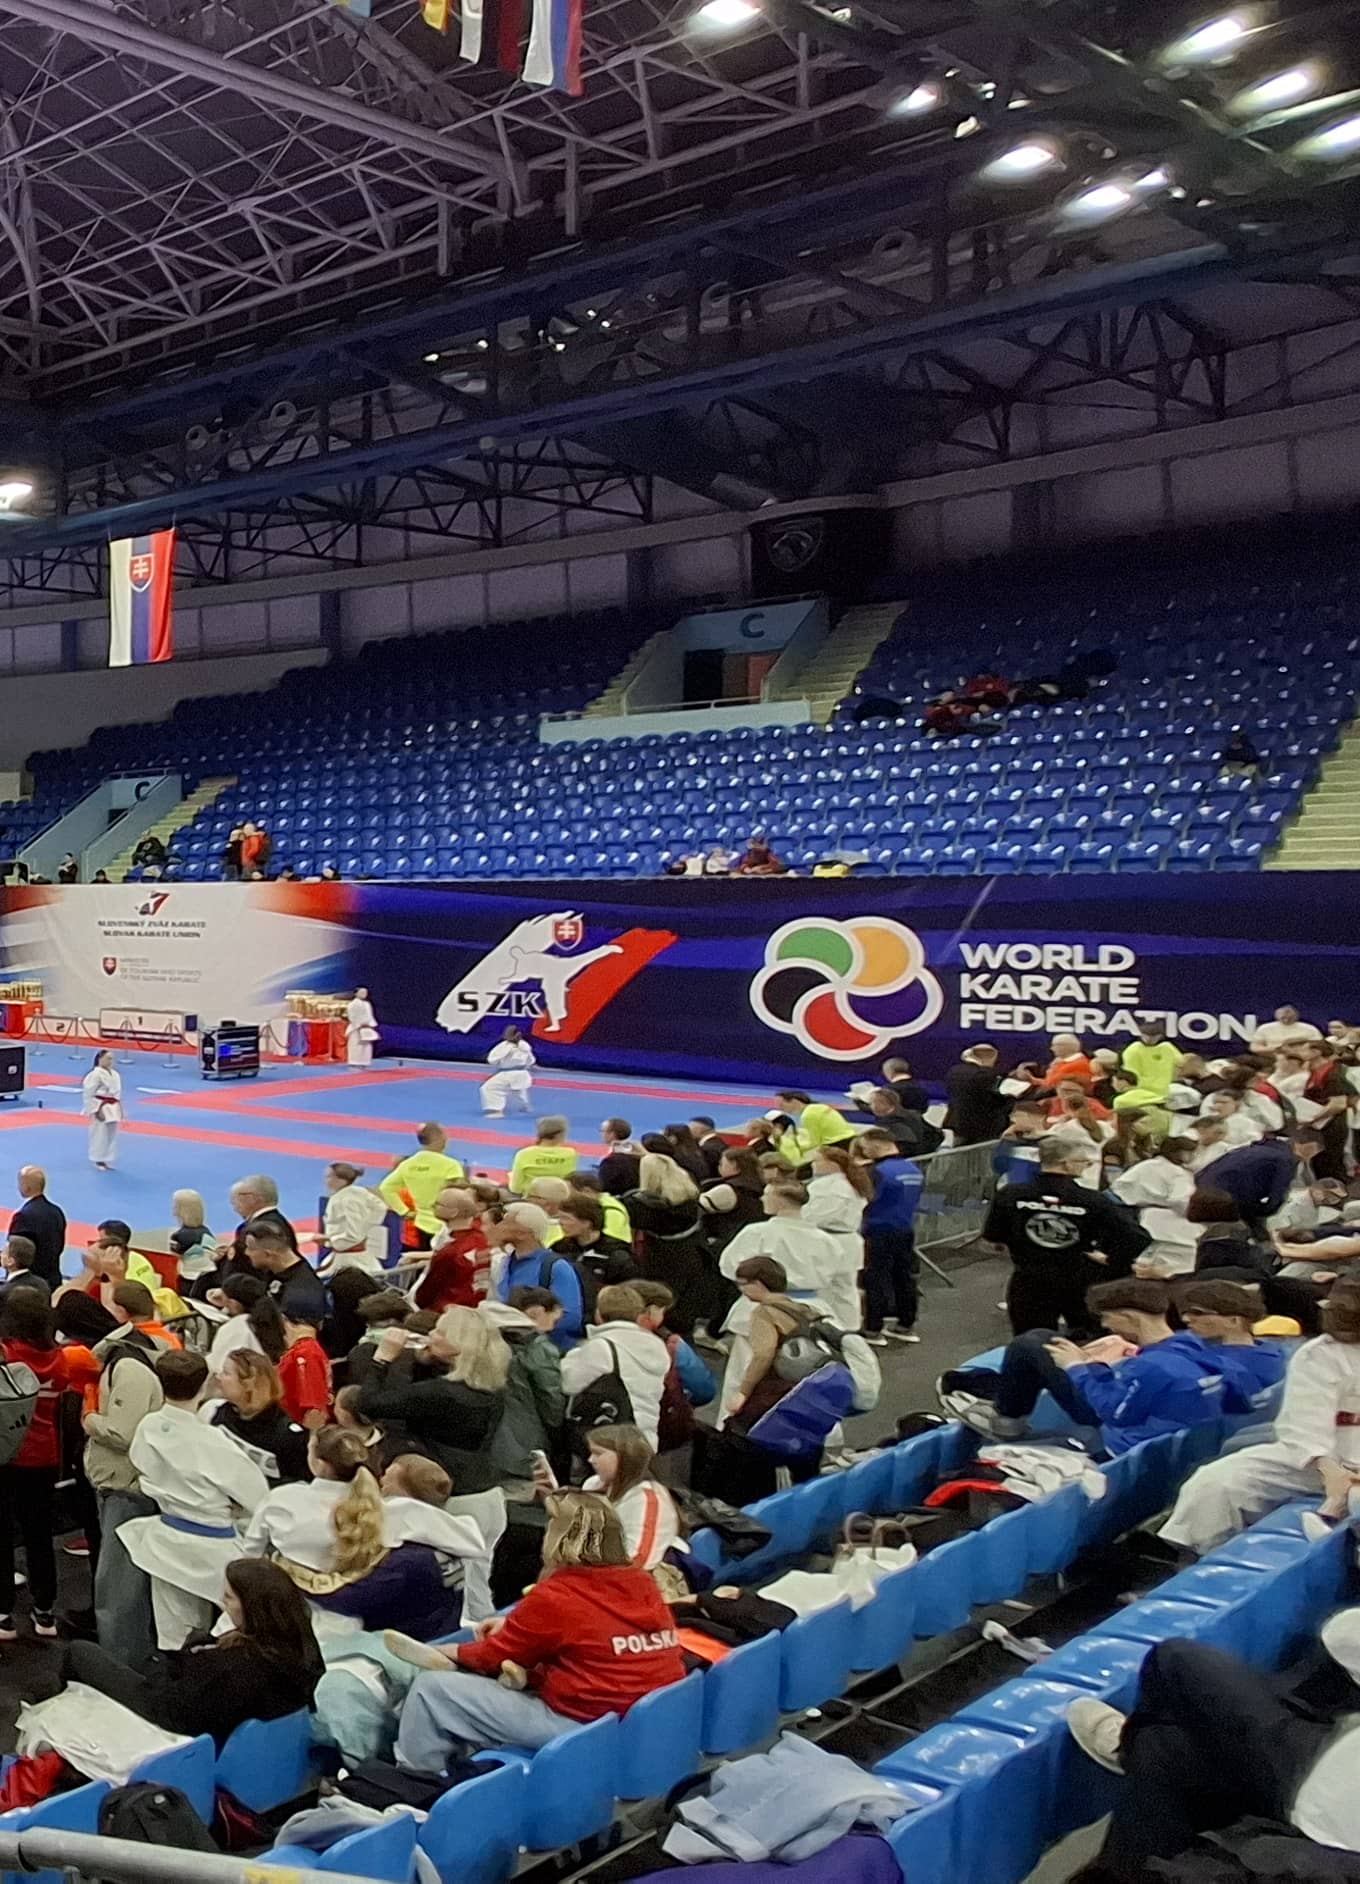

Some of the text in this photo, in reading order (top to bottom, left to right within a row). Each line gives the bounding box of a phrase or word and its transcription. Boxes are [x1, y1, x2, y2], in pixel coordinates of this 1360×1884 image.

[741, 612, 765, 638] C
[135, 781, 150, 802] C
[959, 943, 1136, 972] WORLD
[959, 973, 1140, 1005] KARATE
[457, 990, 545, 1018] SZK
[1016, 1201, 1086, 1215] POLAND
